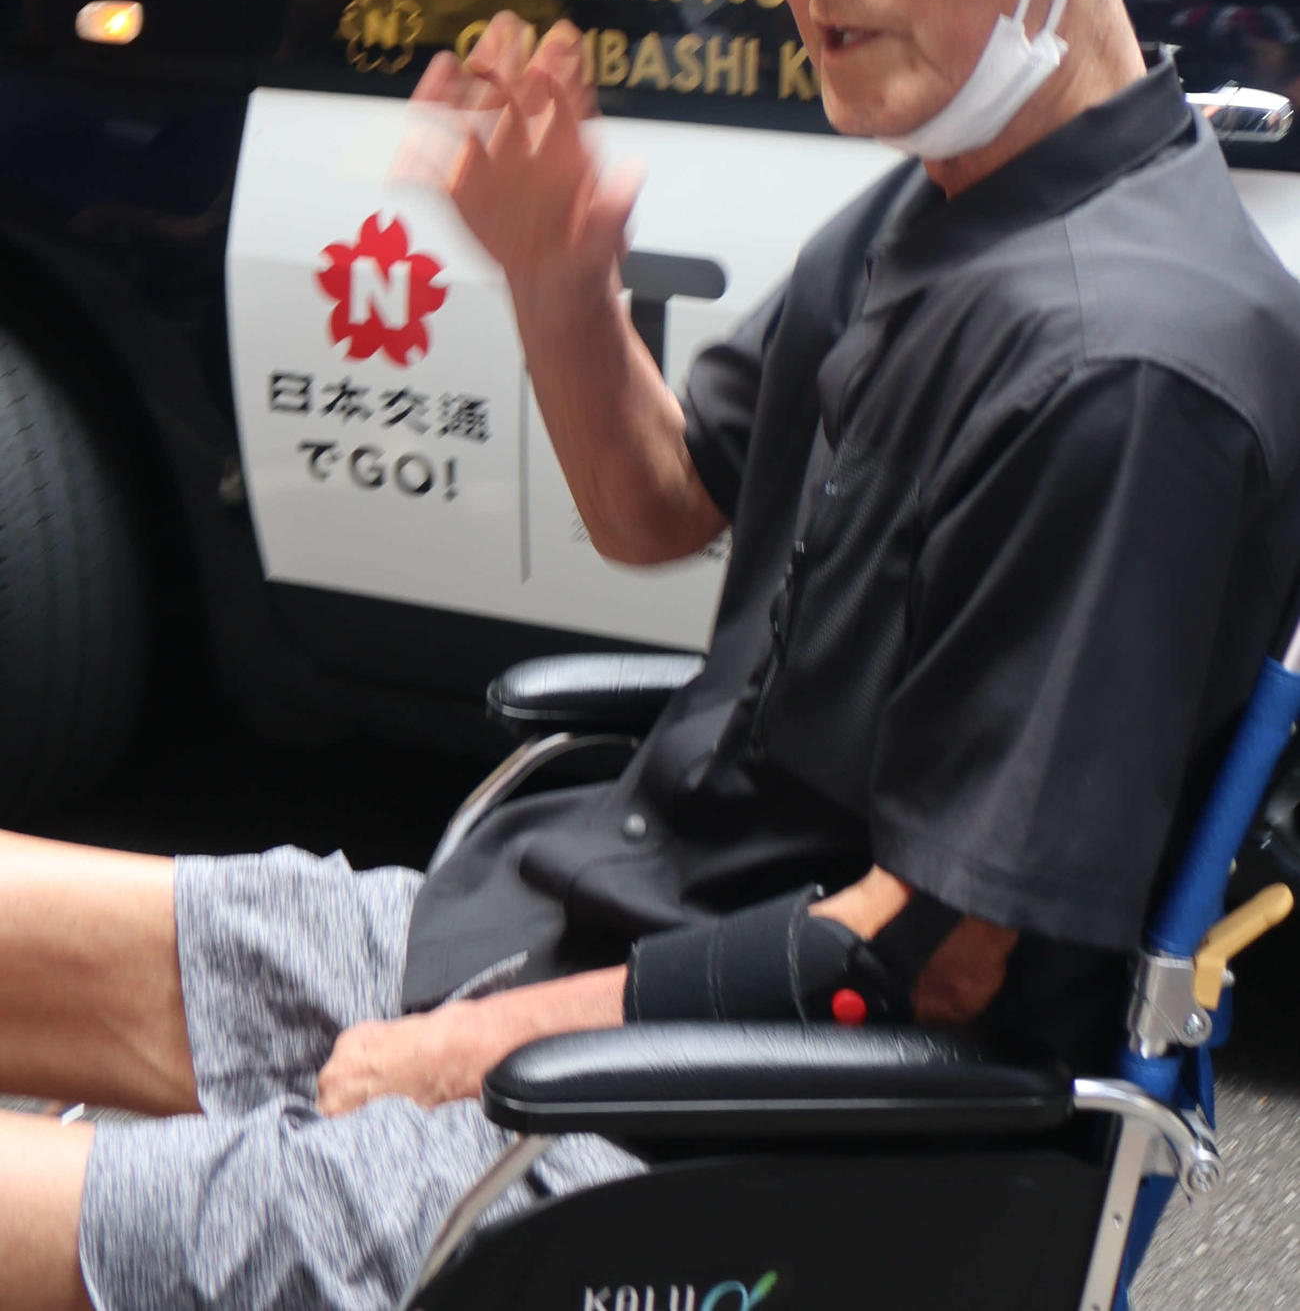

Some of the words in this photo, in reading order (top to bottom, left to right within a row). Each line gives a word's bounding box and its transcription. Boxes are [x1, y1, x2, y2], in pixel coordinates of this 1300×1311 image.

[348, 255, 412, 330] N
[269, 370, 491, 443] 日本交通
